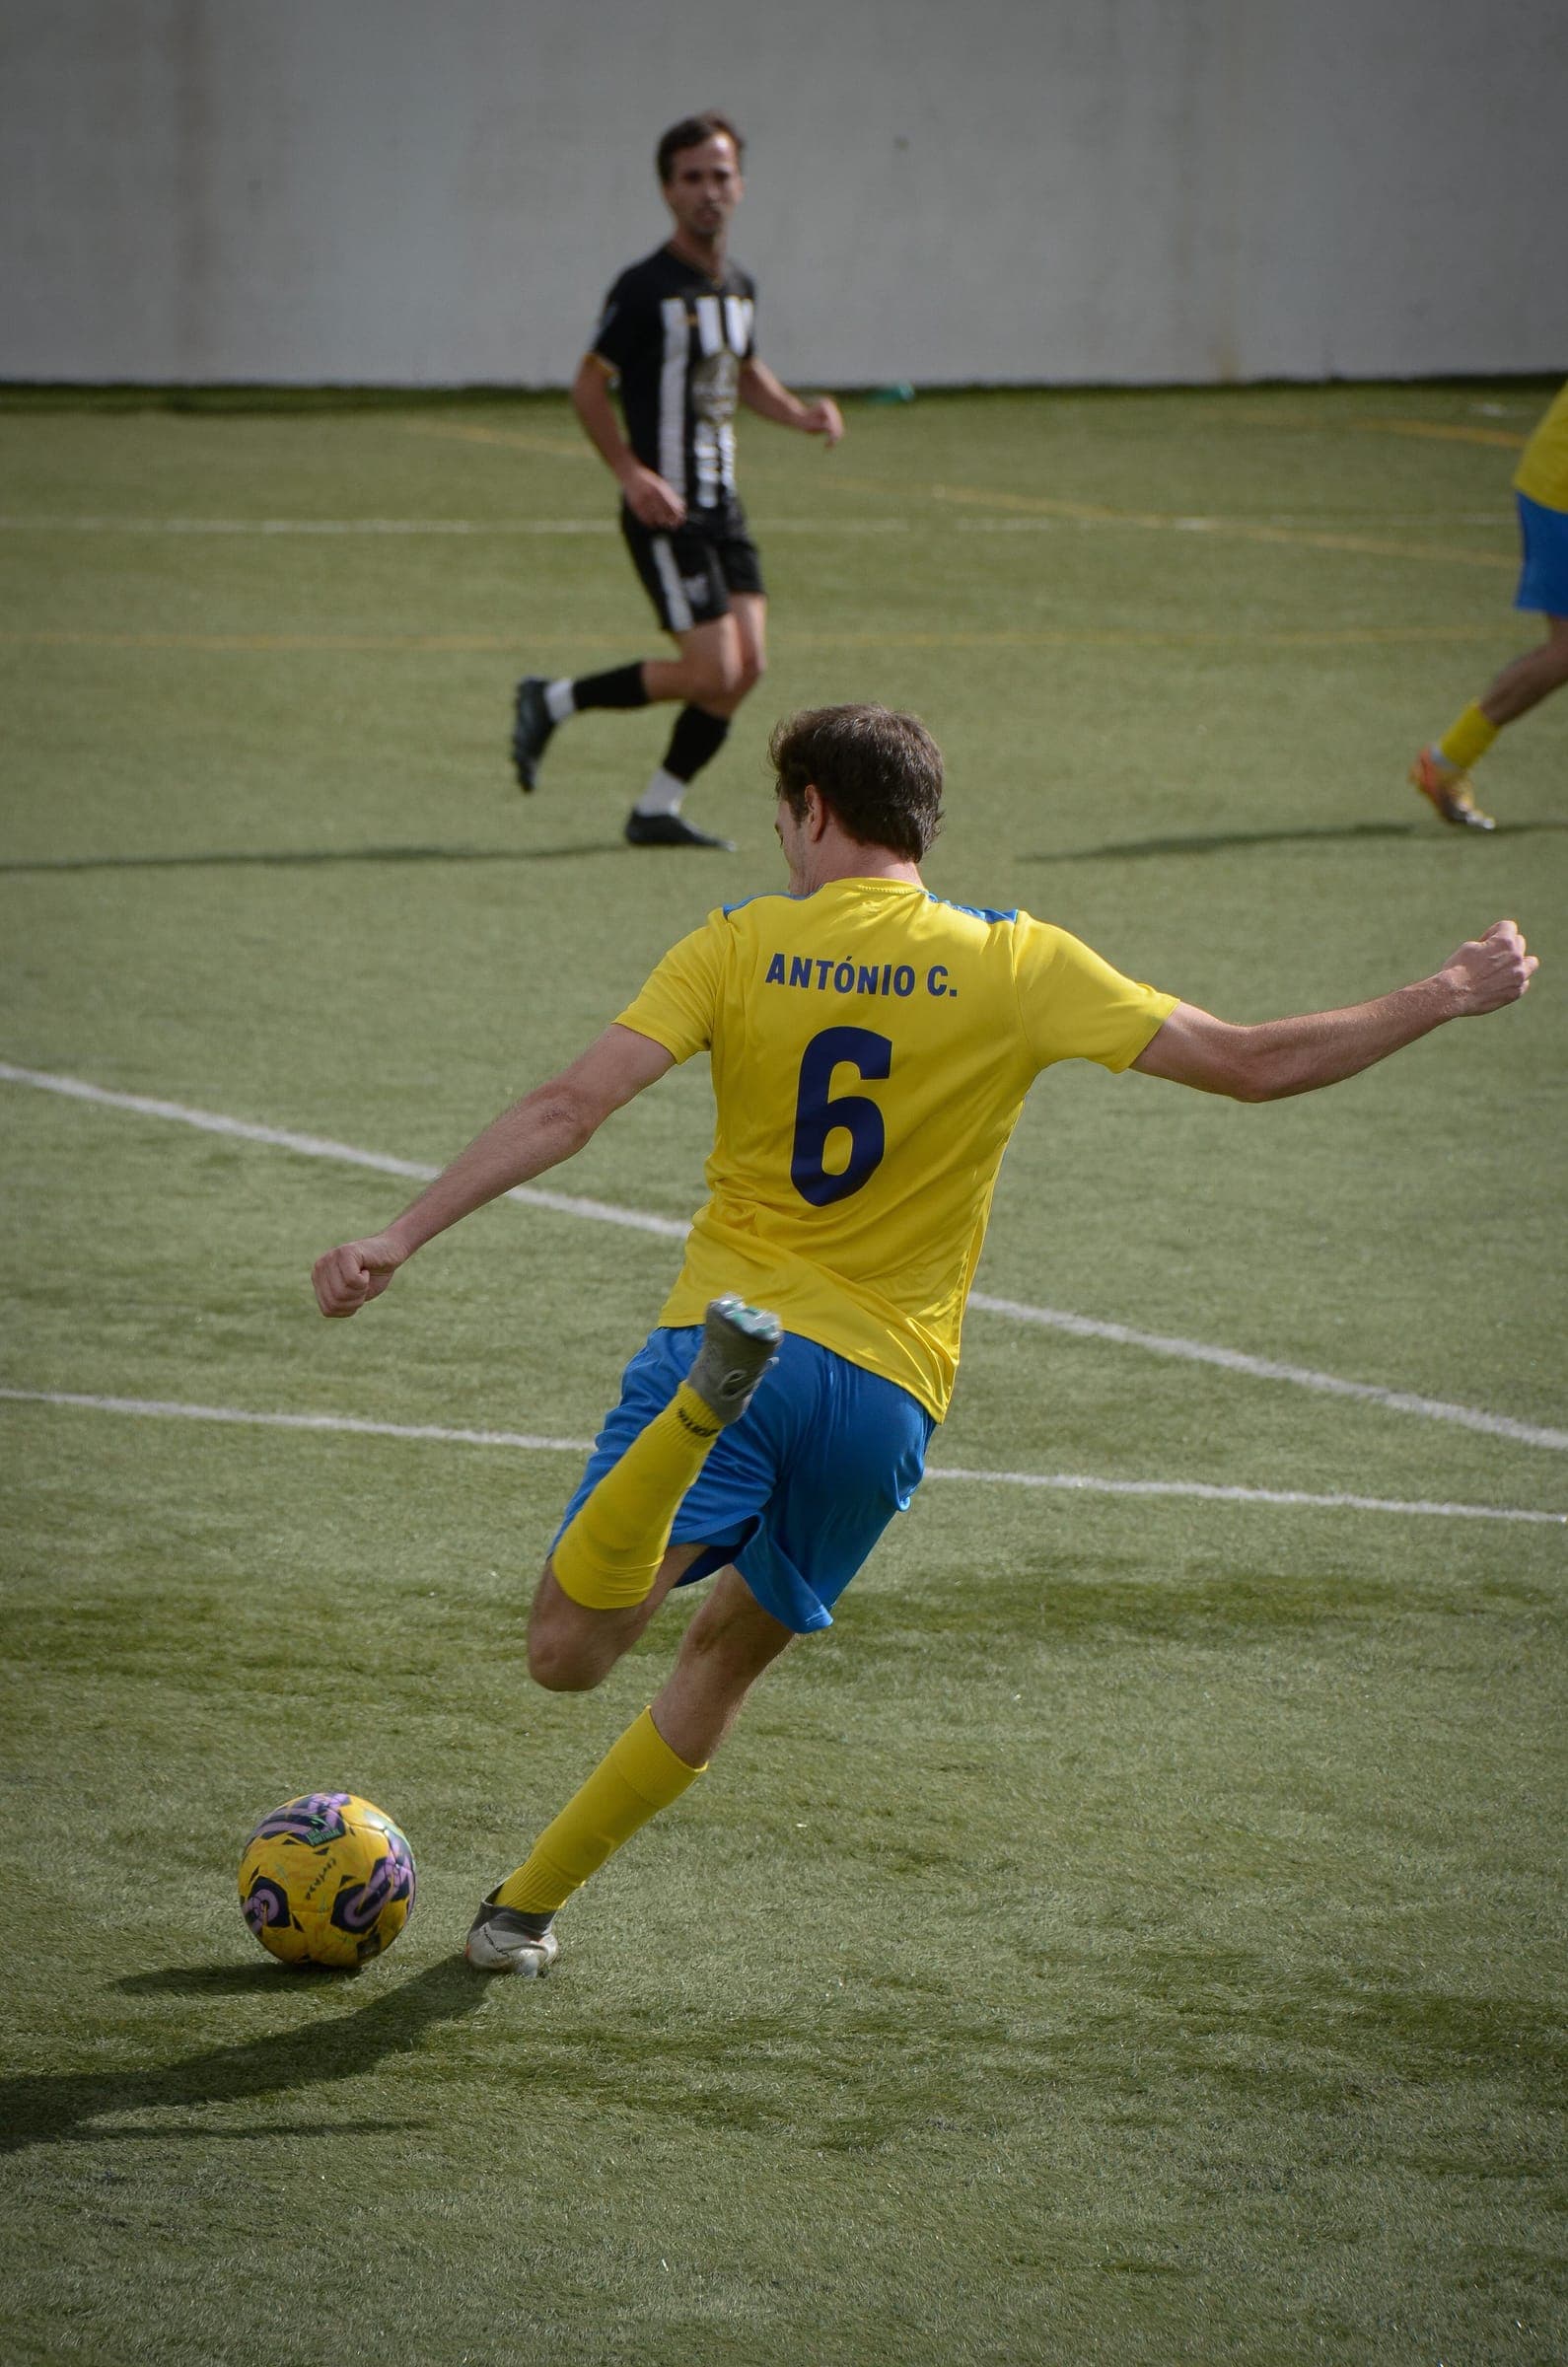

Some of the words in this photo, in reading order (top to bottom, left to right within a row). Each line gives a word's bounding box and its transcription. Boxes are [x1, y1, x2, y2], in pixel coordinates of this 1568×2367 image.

[765, 953, 915, 997] ANTÓNIO
[928, 966, 958, 997] C.
[791, 1027, 892, 1207] 6
